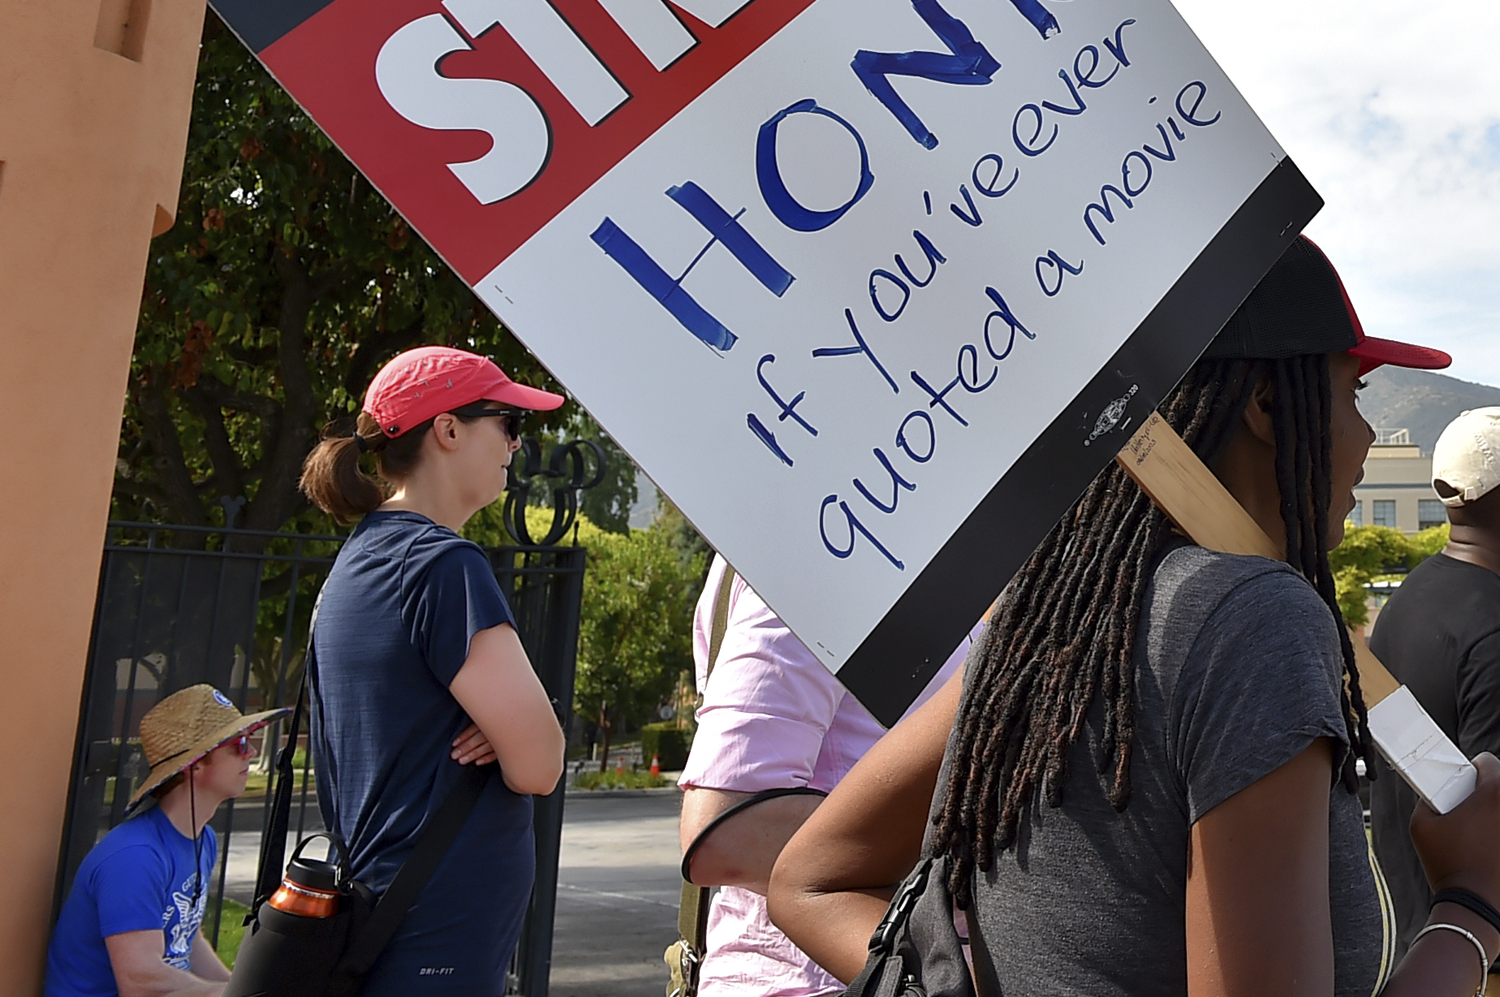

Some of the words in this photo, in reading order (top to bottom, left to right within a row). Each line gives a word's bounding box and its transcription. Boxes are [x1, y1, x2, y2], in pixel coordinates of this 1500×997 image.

[1012, 18, 1136, 156] ever
[819, 286, 1036, 570] quoted
[1034, 248, 1084, 297] a
[1083, 80, 1221, 245] movie
[418, 967, 455, 976] DRI-FIT
